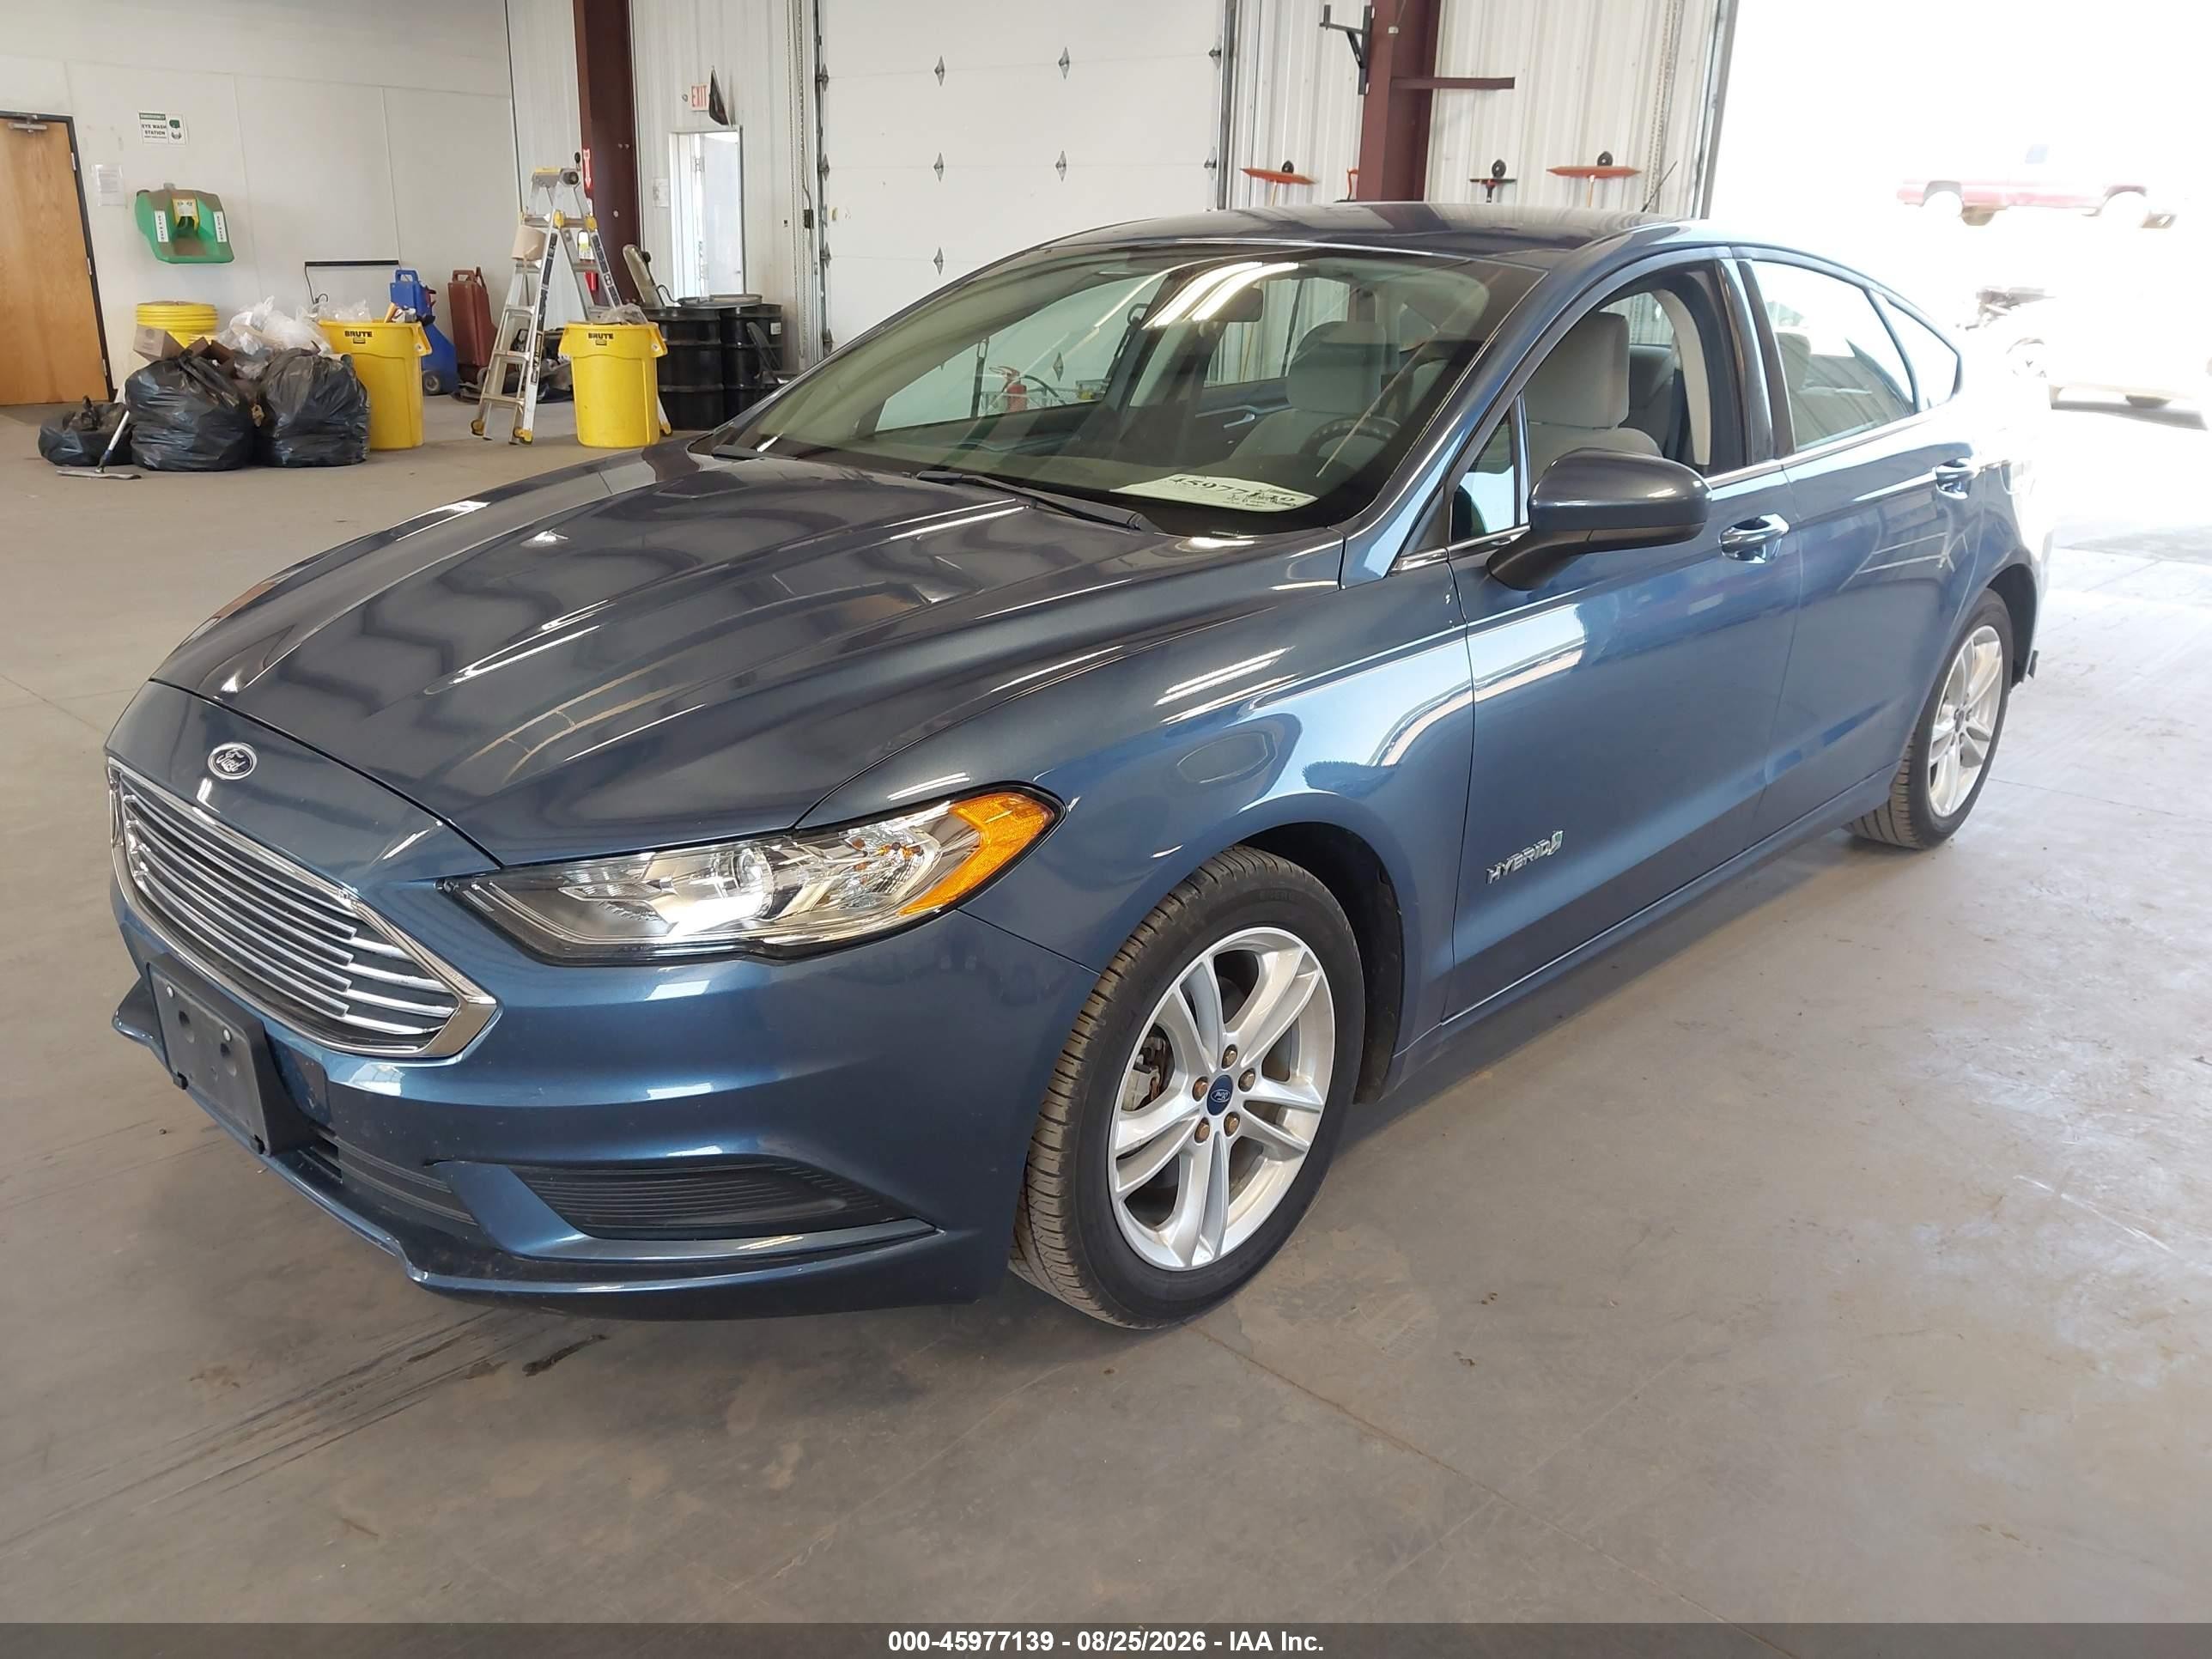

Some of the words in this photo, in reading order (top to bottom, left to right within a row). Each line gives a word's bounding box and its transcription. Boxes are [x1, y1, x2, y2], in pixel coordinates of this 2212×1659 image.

[691, 85, 708, 107] EXIT
[216, 749, 246, 772] Ford
[1485, 839, 1551, 884] HYBRID
